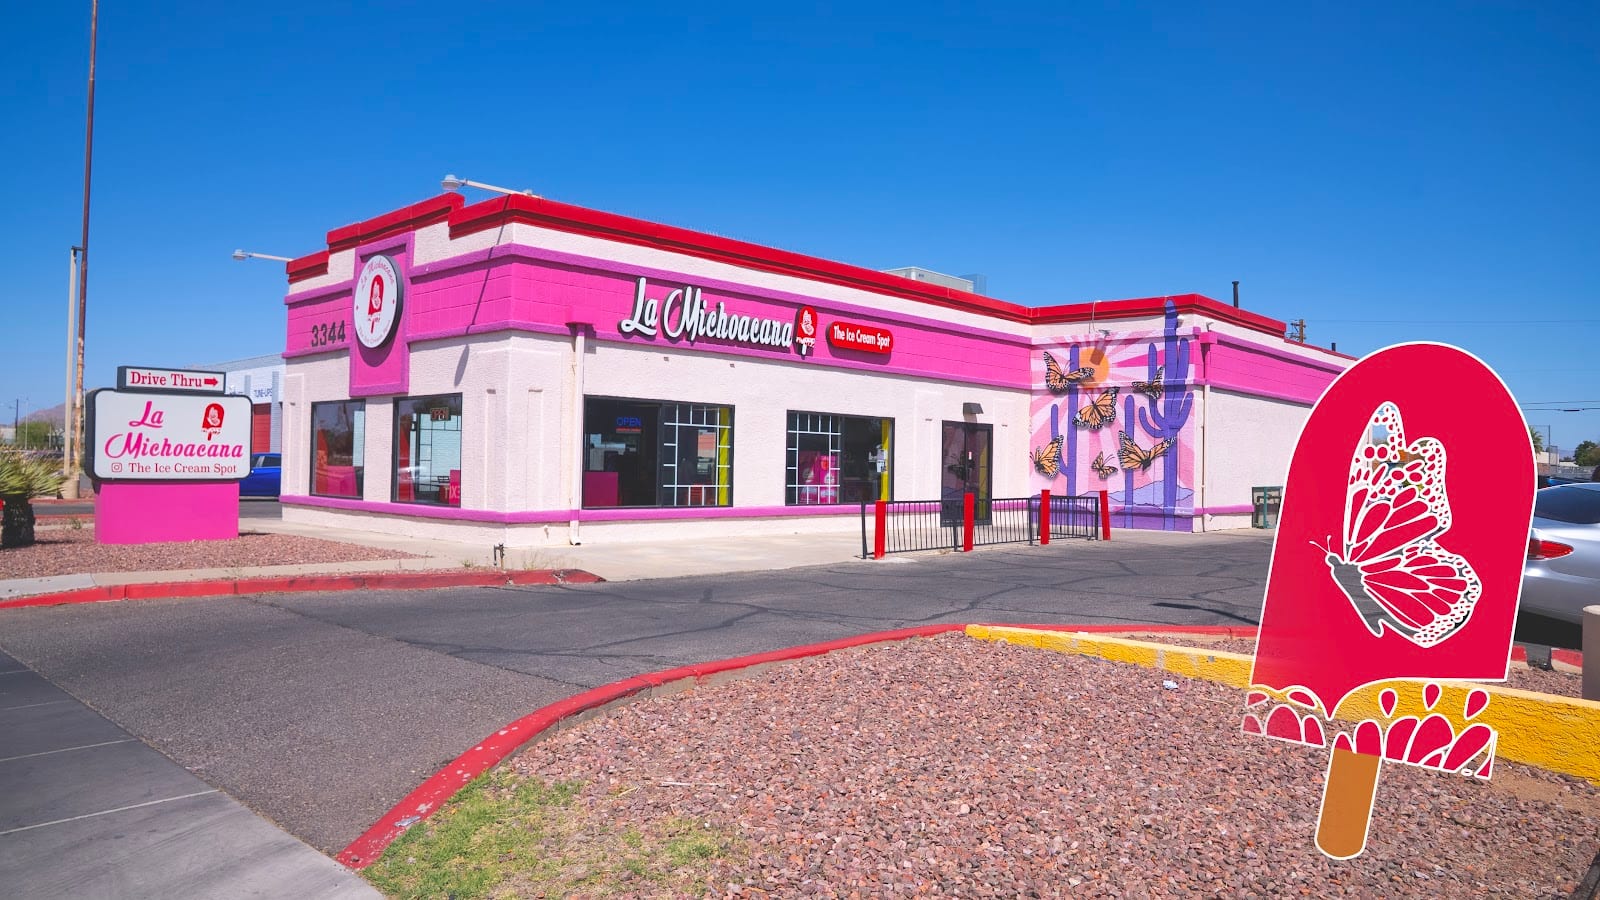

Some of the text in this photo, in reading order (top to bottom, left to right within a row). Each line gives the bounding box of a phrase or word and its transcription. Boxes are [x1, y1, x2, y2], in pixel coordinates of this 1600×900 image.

[621, 277, 793, 348] La Michoacana
[311, 320, 346, 347] 3344
[833, 325, 890, 350] The Ice Cream Spot
[130, 371, 202, 387] Drive Thru
[129, 401, 164, 428] La
[616, 417, 642, 427] OPEN
[104, 432, 243, 459] Michoacana
[128, 462, 237, 476] The Ice Cream Spot
